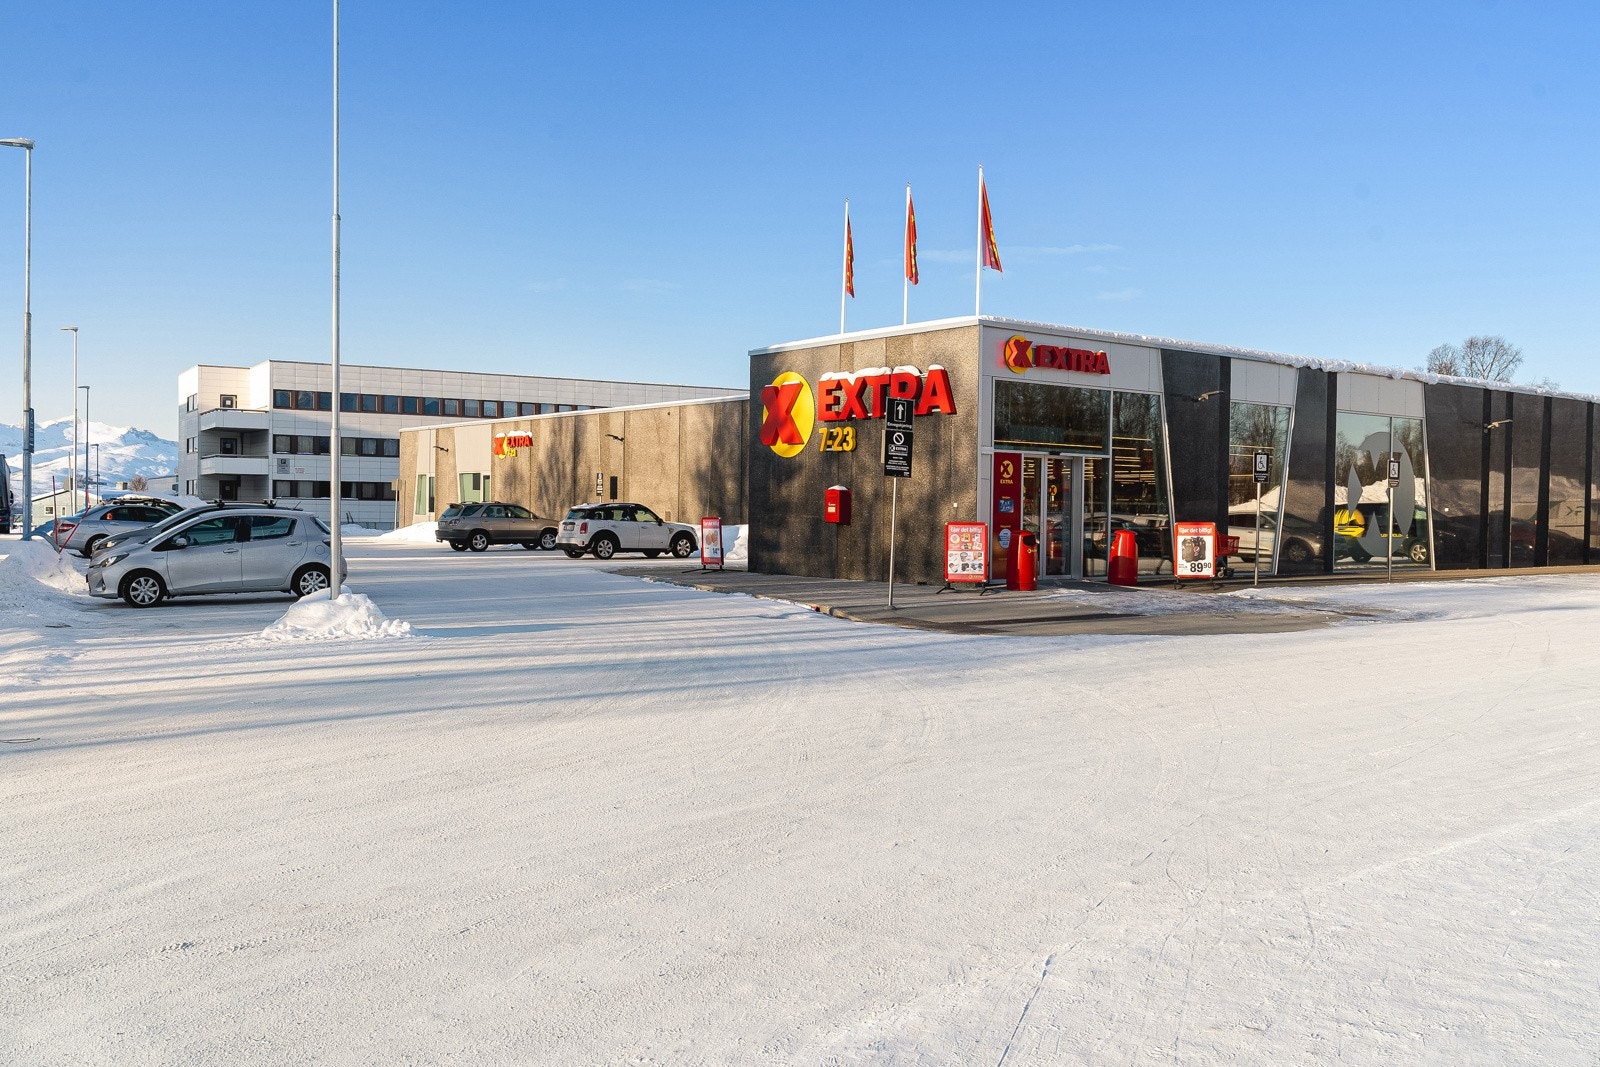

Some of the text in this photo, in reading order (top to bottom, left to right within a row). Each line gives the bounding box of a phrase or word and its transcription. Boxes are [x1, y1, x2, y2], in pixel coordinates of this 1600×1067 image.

[1035, 344, 1111, 375] EXTRA
[817, 368, 957, 421] EXTRA
[506, 434, 533, 448] EXTRA
[818, 426, 857, 452] 7-23
